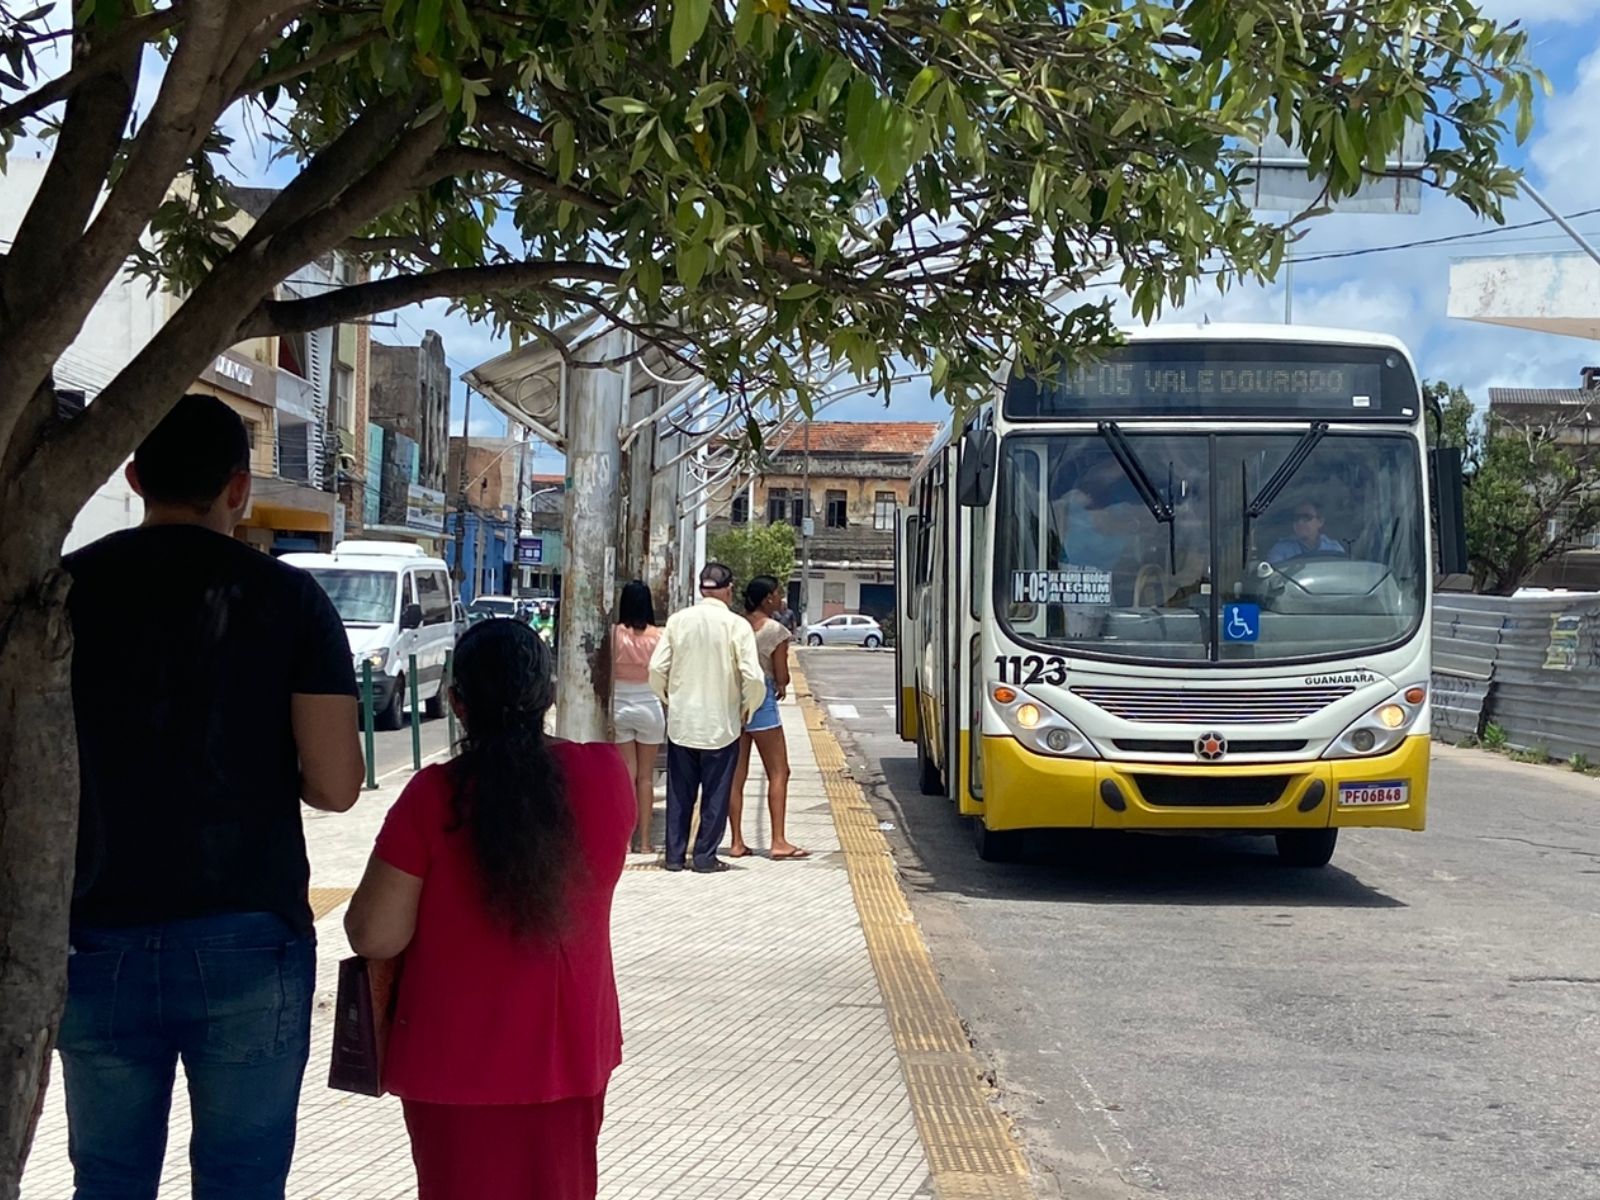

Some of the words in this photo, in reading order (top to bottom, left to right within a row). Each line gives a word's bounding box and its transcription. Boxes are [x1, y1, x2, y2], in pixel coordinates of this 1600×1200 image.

[1144, 369, 1214, 393] VALE
[1220, 369, 1343, 393] DOURADO
[1015, 572, 1047, 602] N-05
[1049, 583, 1110, 593] ALECRIM
[995, 655, 1067, 686] 1123
[1305, 674, 1374, 685] GUANABARA
